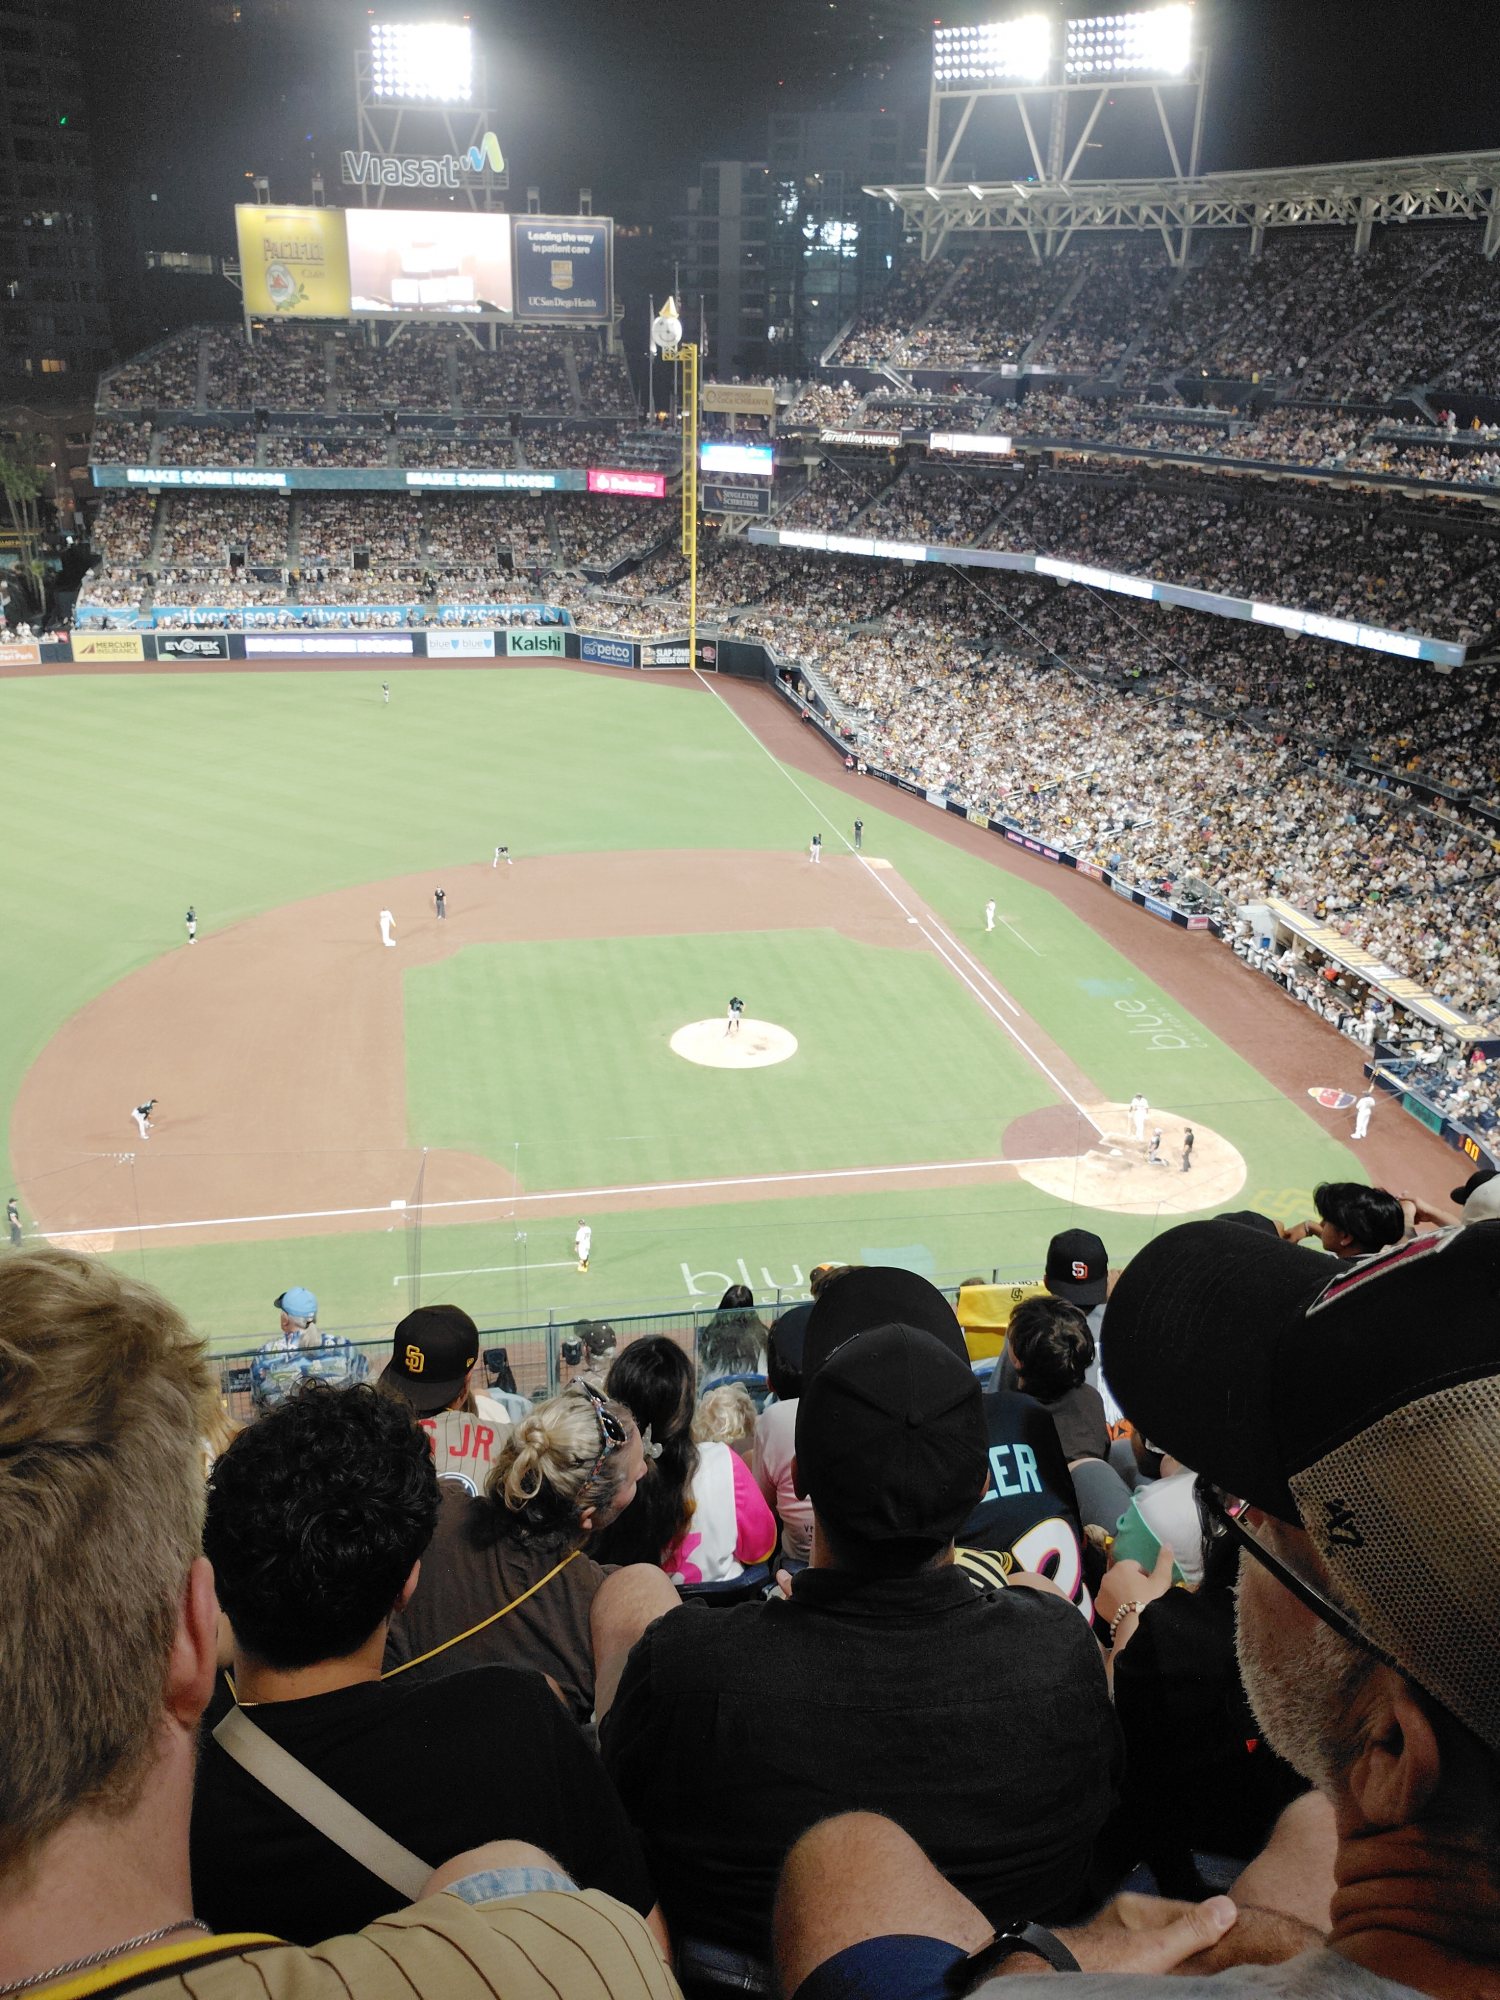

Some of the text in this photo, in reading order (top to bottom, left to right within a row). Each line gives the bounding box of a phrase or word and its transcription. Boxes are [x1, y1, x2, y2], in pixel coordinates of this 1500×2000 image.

[345, 150, 460, 188] Viasat
[528, 231, 595, 245] Leading the way
[541, 244, 571, 254] patient
[571, 246, 591, 254] care
[864, 435, 899, 446] SAUSAGES
[127, 469, 287, 486] MAKE SOME NOISE
[406, 472, 555, 488] MAKE SOME NOISE
[96, 641, 138, 649] MERCURY
[512, 636, 561, 651] Kalshi
[597, 643, 630, 658] petco
[1113, 999, 1191, 1050] blue
[680, 1258, 849, 1296] blu
[1072, 1261, 1089, 1280] SD
[405, 1344, 425, 1374] SD
